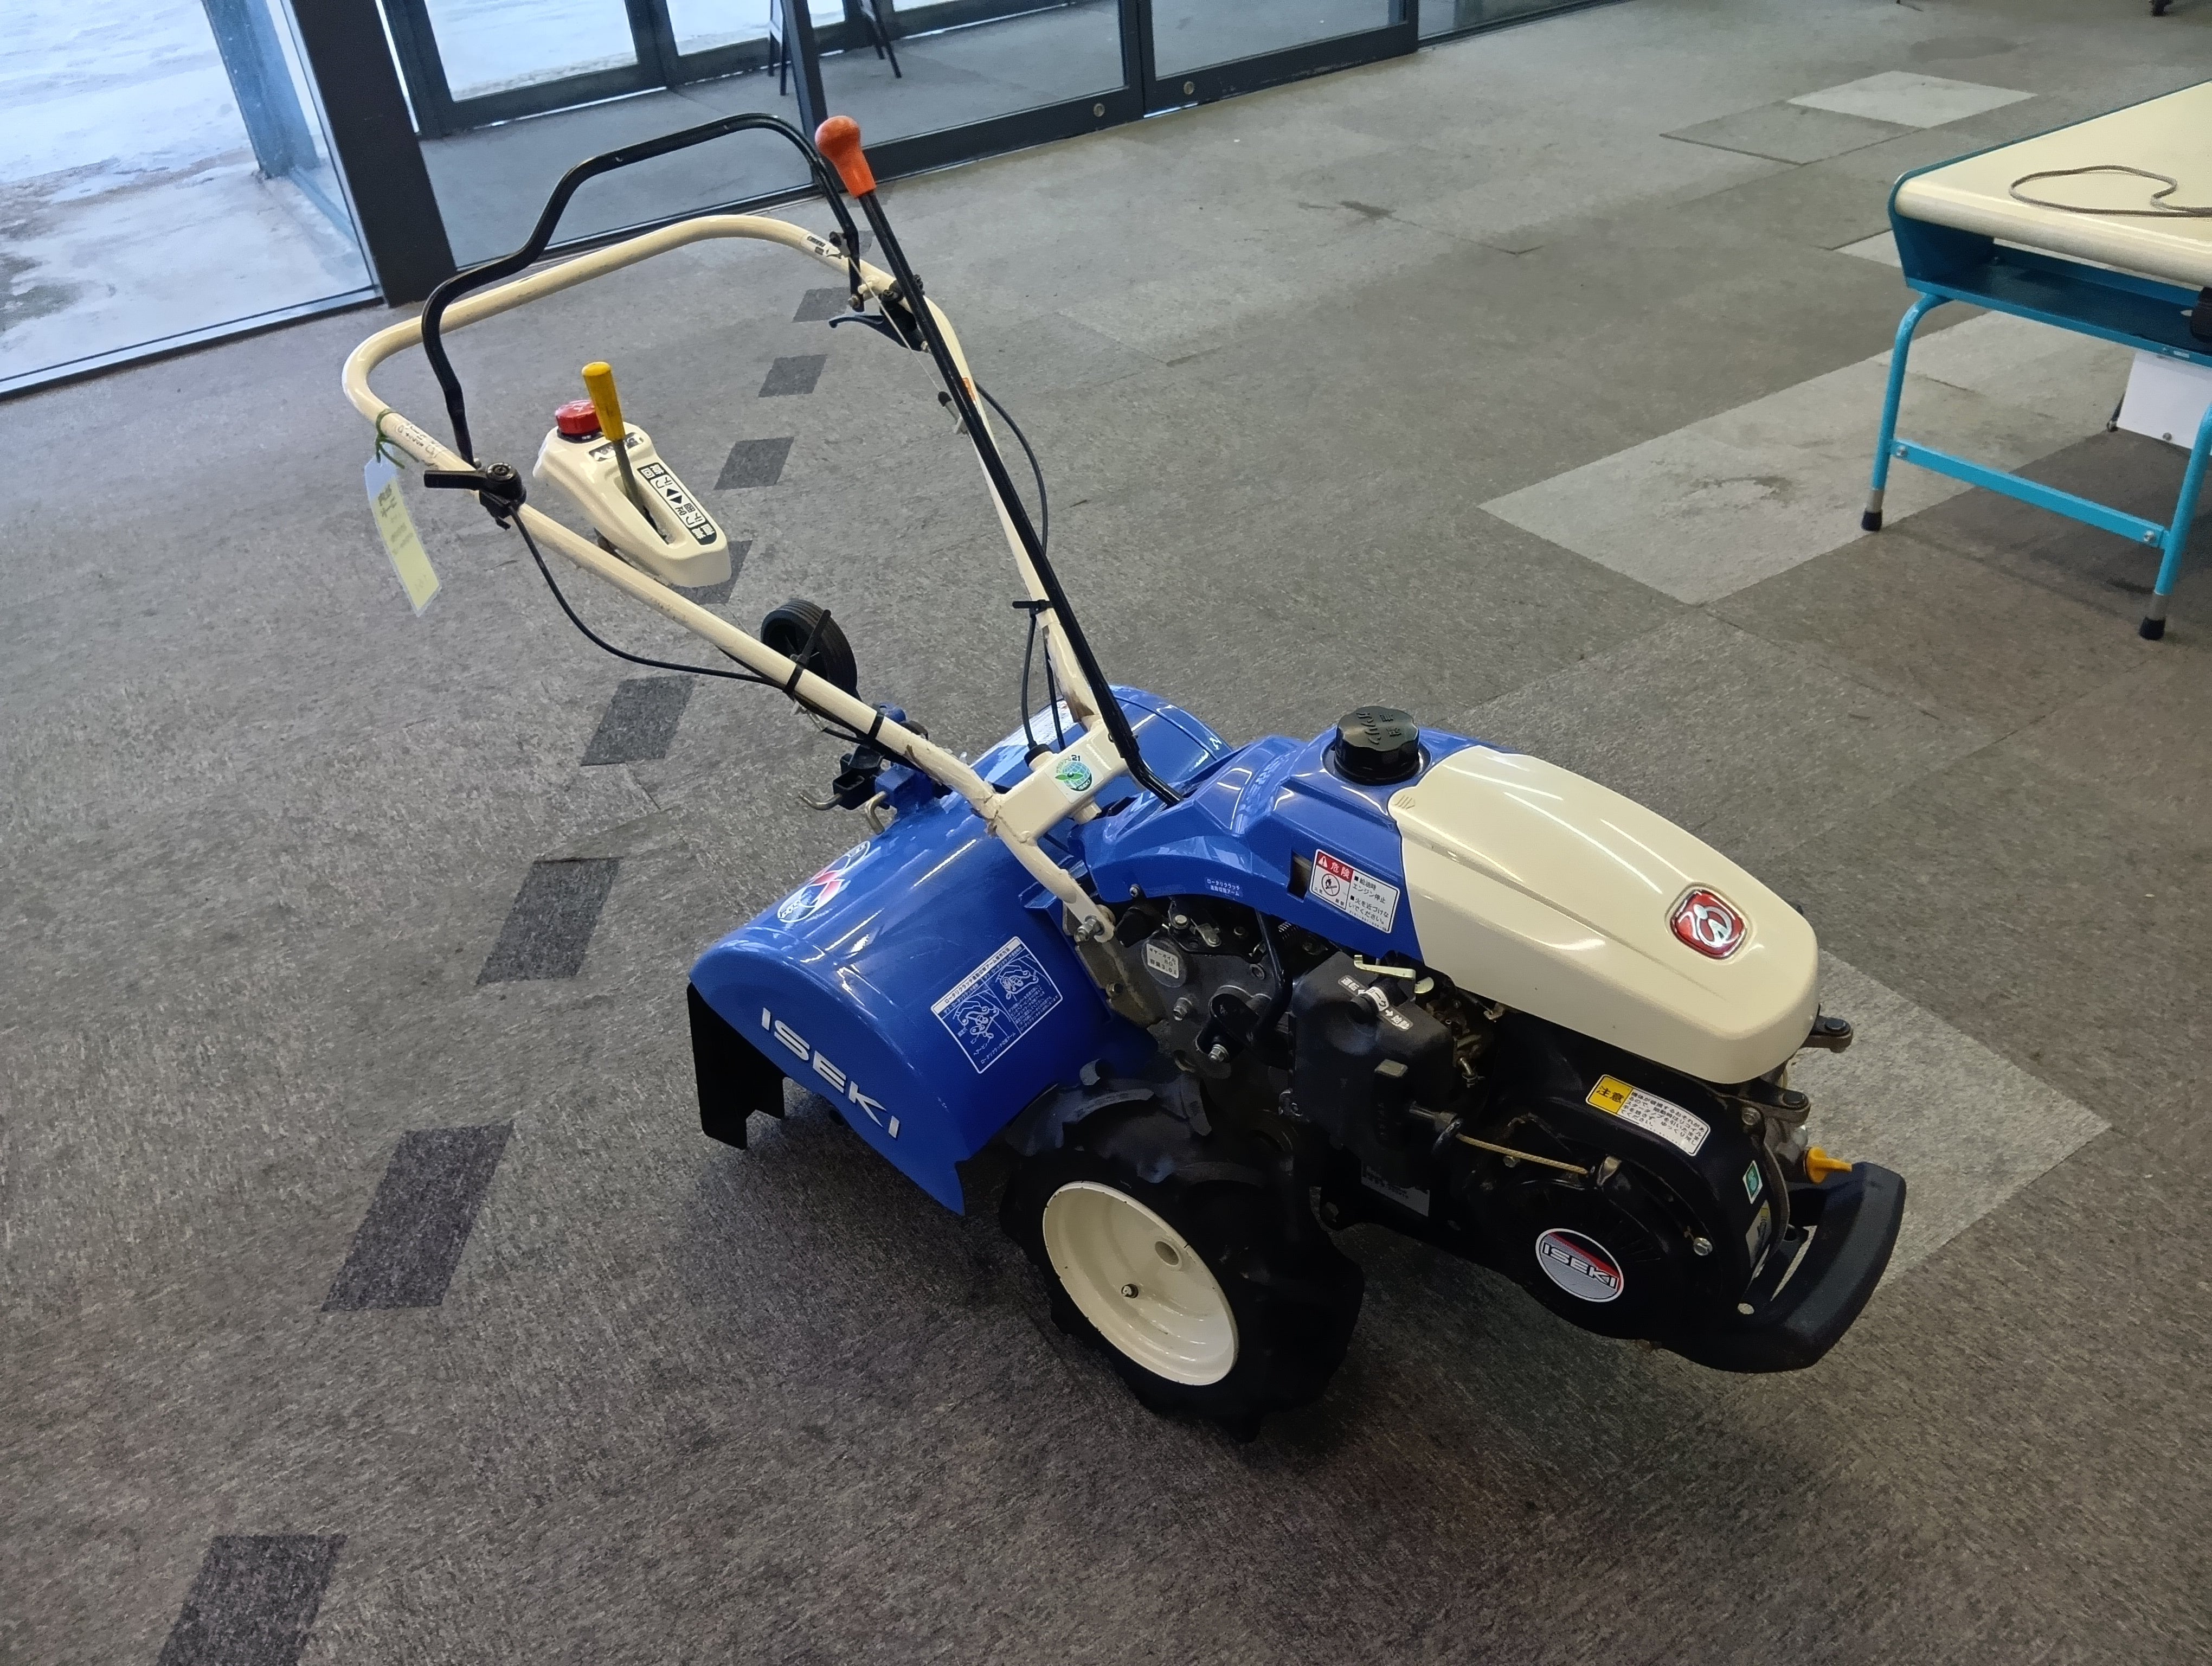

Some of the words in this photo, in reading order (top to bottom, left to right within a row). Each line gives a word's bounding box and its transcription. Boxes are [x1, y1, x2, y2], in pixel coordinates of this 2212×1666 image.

[675, 503, 695, 516] 固定
[686, 512, 703, 526] デフ
[1330, 861, 1351, 879] 危険
[1352, 883, 1386, 904] エンジン停止
[1348, 902, 1385, 925] いでください。
[1355, 898, 1390, 918] 火を近づけな
[762, 1007, 900, 1139] ISEKI
[1596, 1085, 1625, 1104] 注意
[1543, 1242, 1617, 1289] ISEKI
